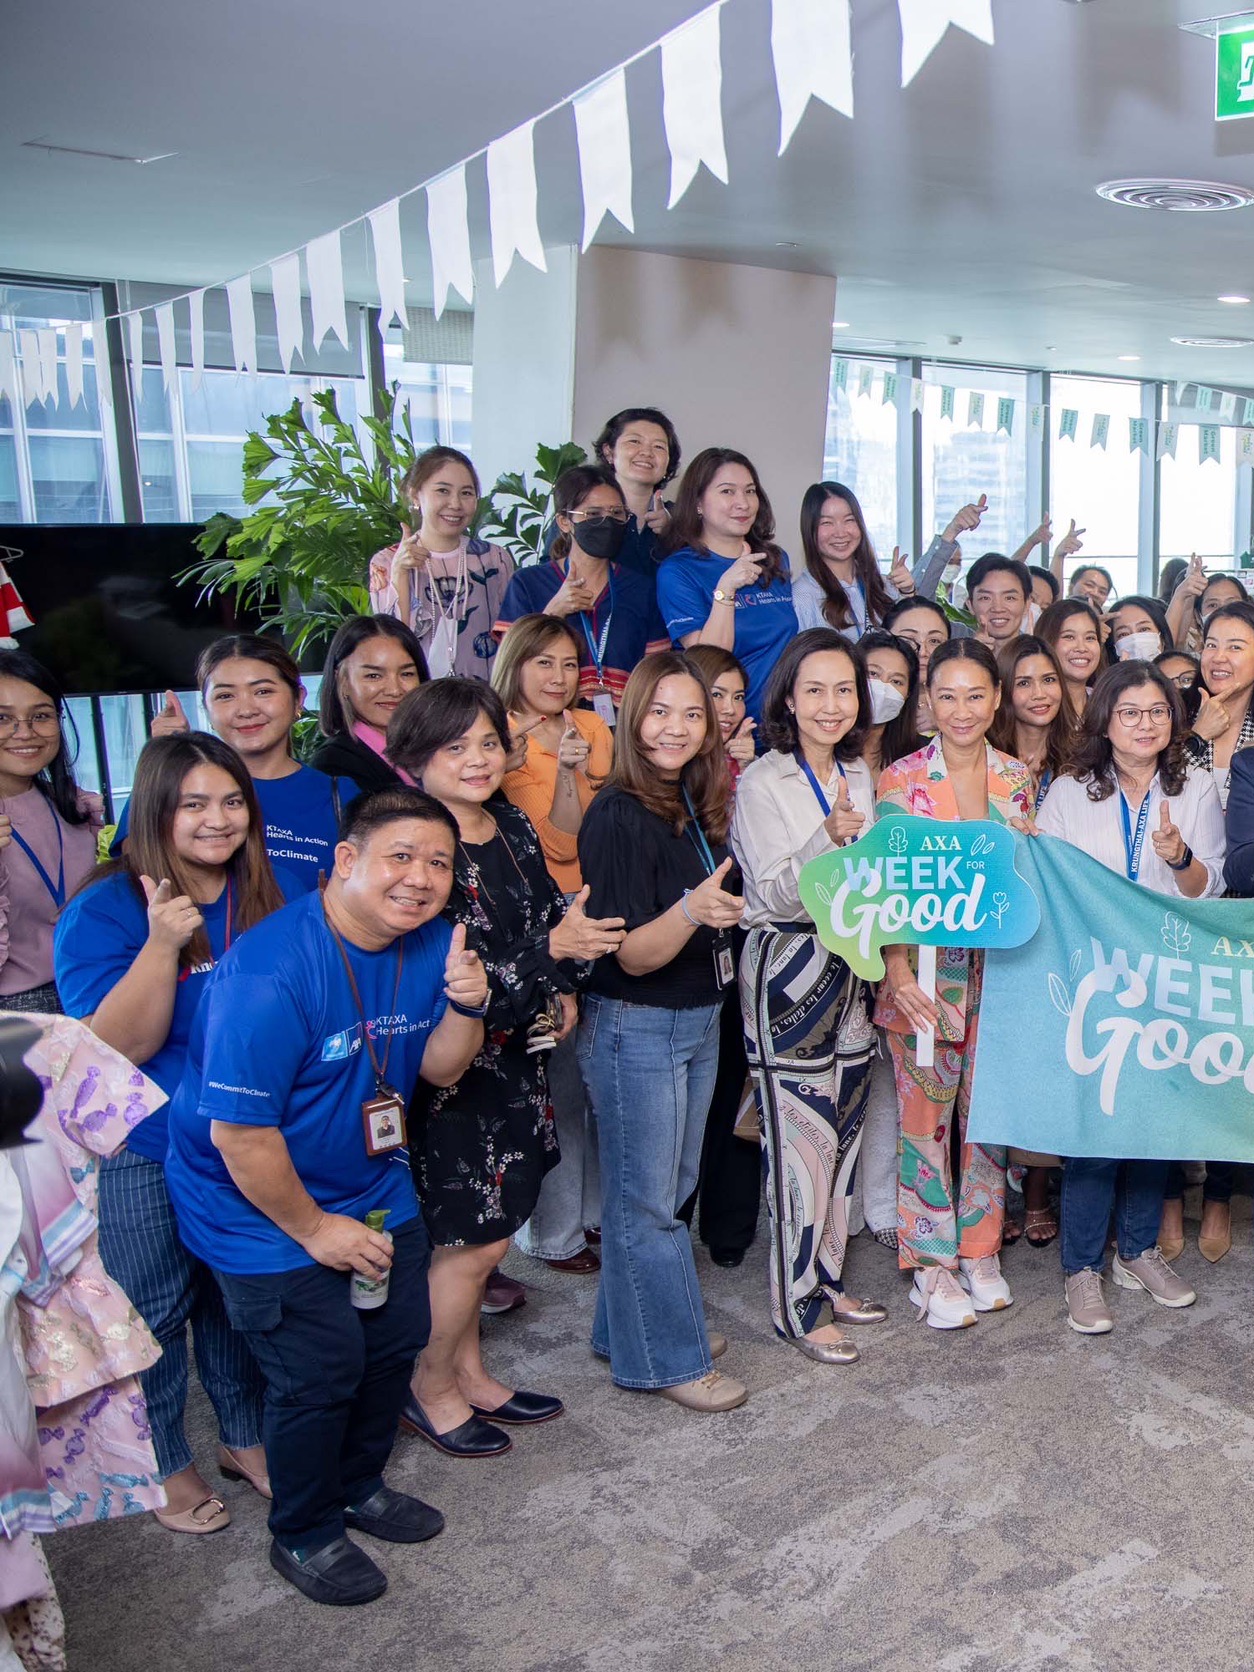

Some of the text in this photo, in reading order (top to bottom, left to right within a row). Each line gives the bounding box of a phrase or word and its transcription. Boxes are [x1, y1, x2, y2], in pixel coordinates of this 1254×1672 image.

[266, 825, 293, 836] KTAXA
[266, 831, 294, 841] Hearts
[304, 836, 329, 847] Action
[920, 835, 962, 851] AXA
[1131, 815, 1147, 873] KRUNGTHAI-AXA
[843, 856, 985, 892] WEEK FOR
[830, 868, 988, 960] Good
[376, 1014, 407, 1026] KTAXA
[409, 1023, 417, 1032] in
